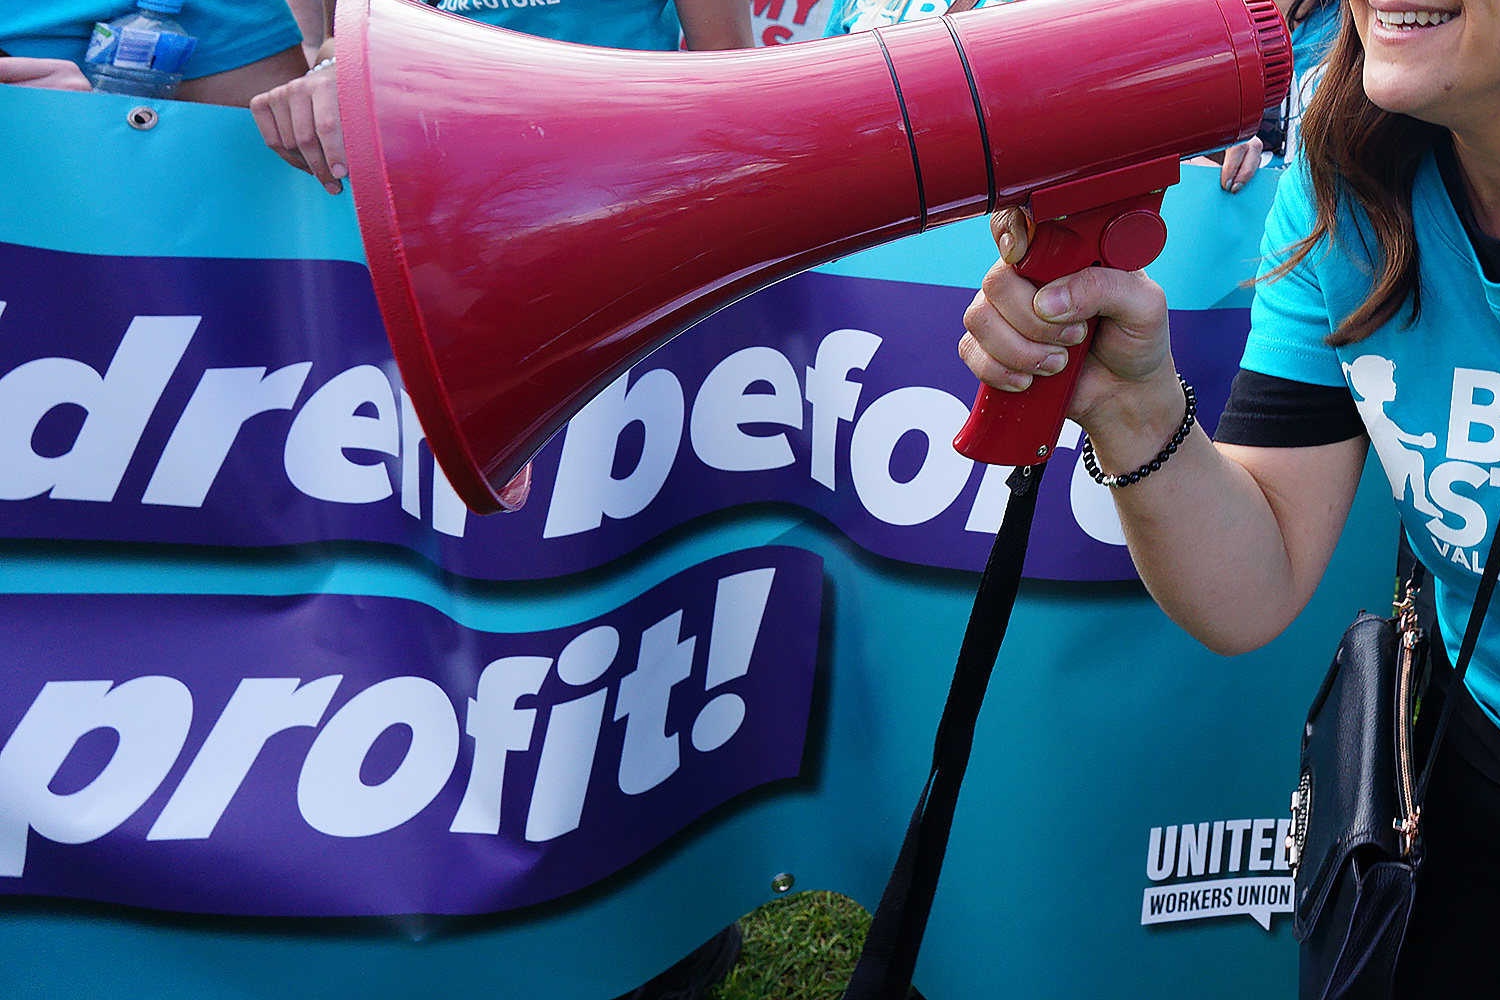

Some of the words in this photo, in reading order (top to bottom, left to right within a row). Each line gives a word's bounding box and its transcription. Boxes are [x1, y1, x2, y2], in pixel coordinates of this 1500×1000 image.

[0, 305, 468, 539] dren
[0, 567, 776, 878] profit!
[1150, 886, 1233, 916] WORKERS
[1237, 884, 1291, 906] UNION
